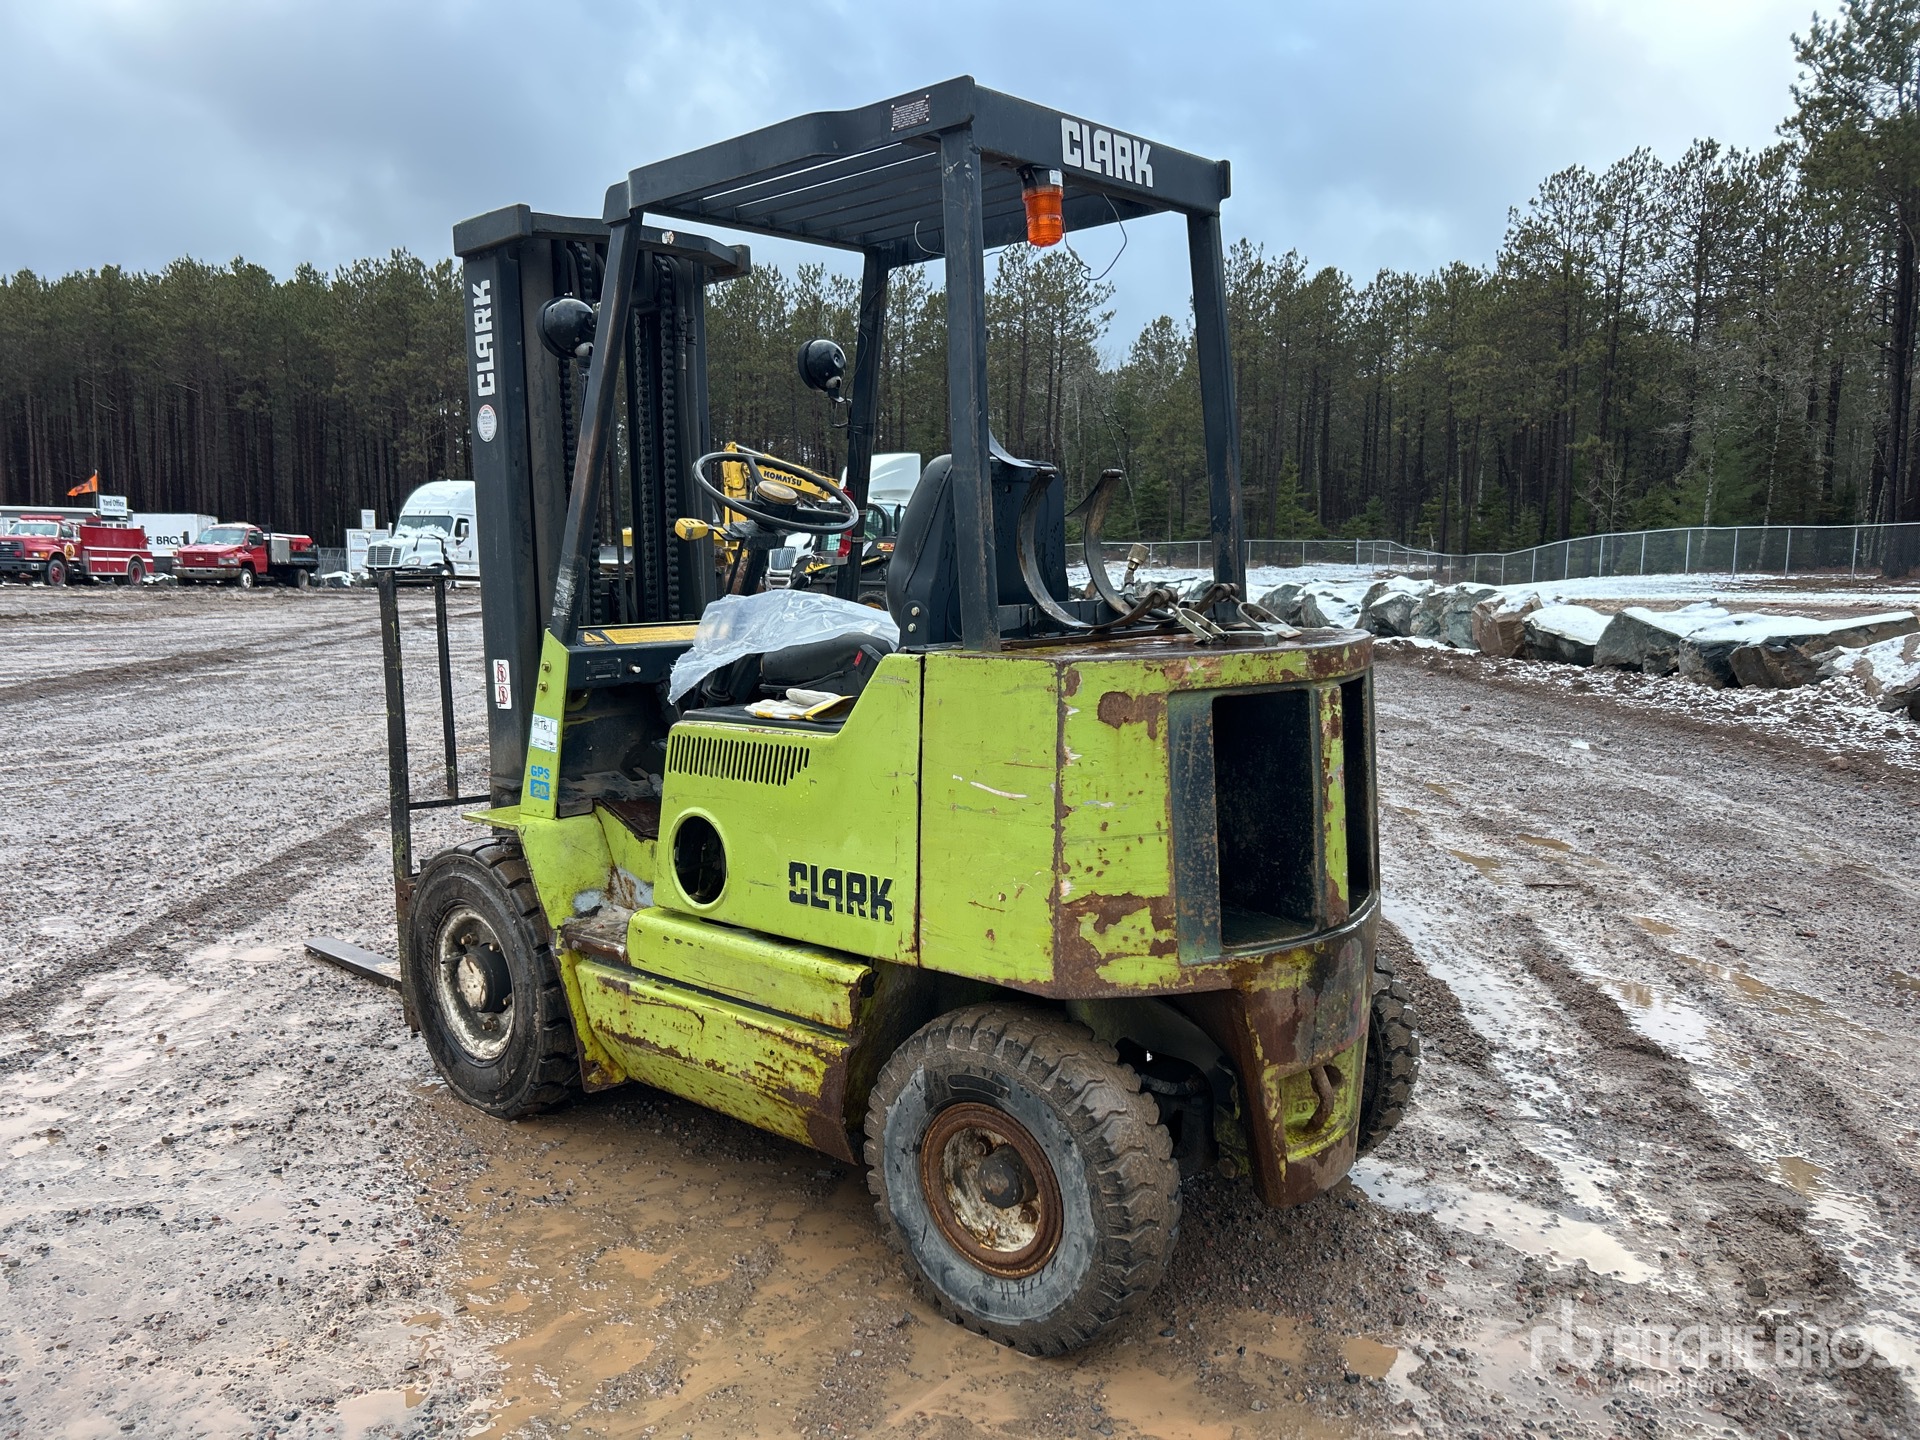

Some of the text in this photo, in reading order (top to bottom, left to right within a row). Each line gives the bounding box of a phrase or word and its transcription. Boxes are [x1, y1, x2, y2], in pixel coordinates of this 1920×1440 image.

[1061, 118, 1153, 188] CLARK
[472, 279, 496, 397] CLARK
[763, 470, 802, 487] KOMATSU
[102, 499, 125, 508] Yard Office
[531, 765, 550, 780] GPS
[788, 860, 894, 923] CLARK
